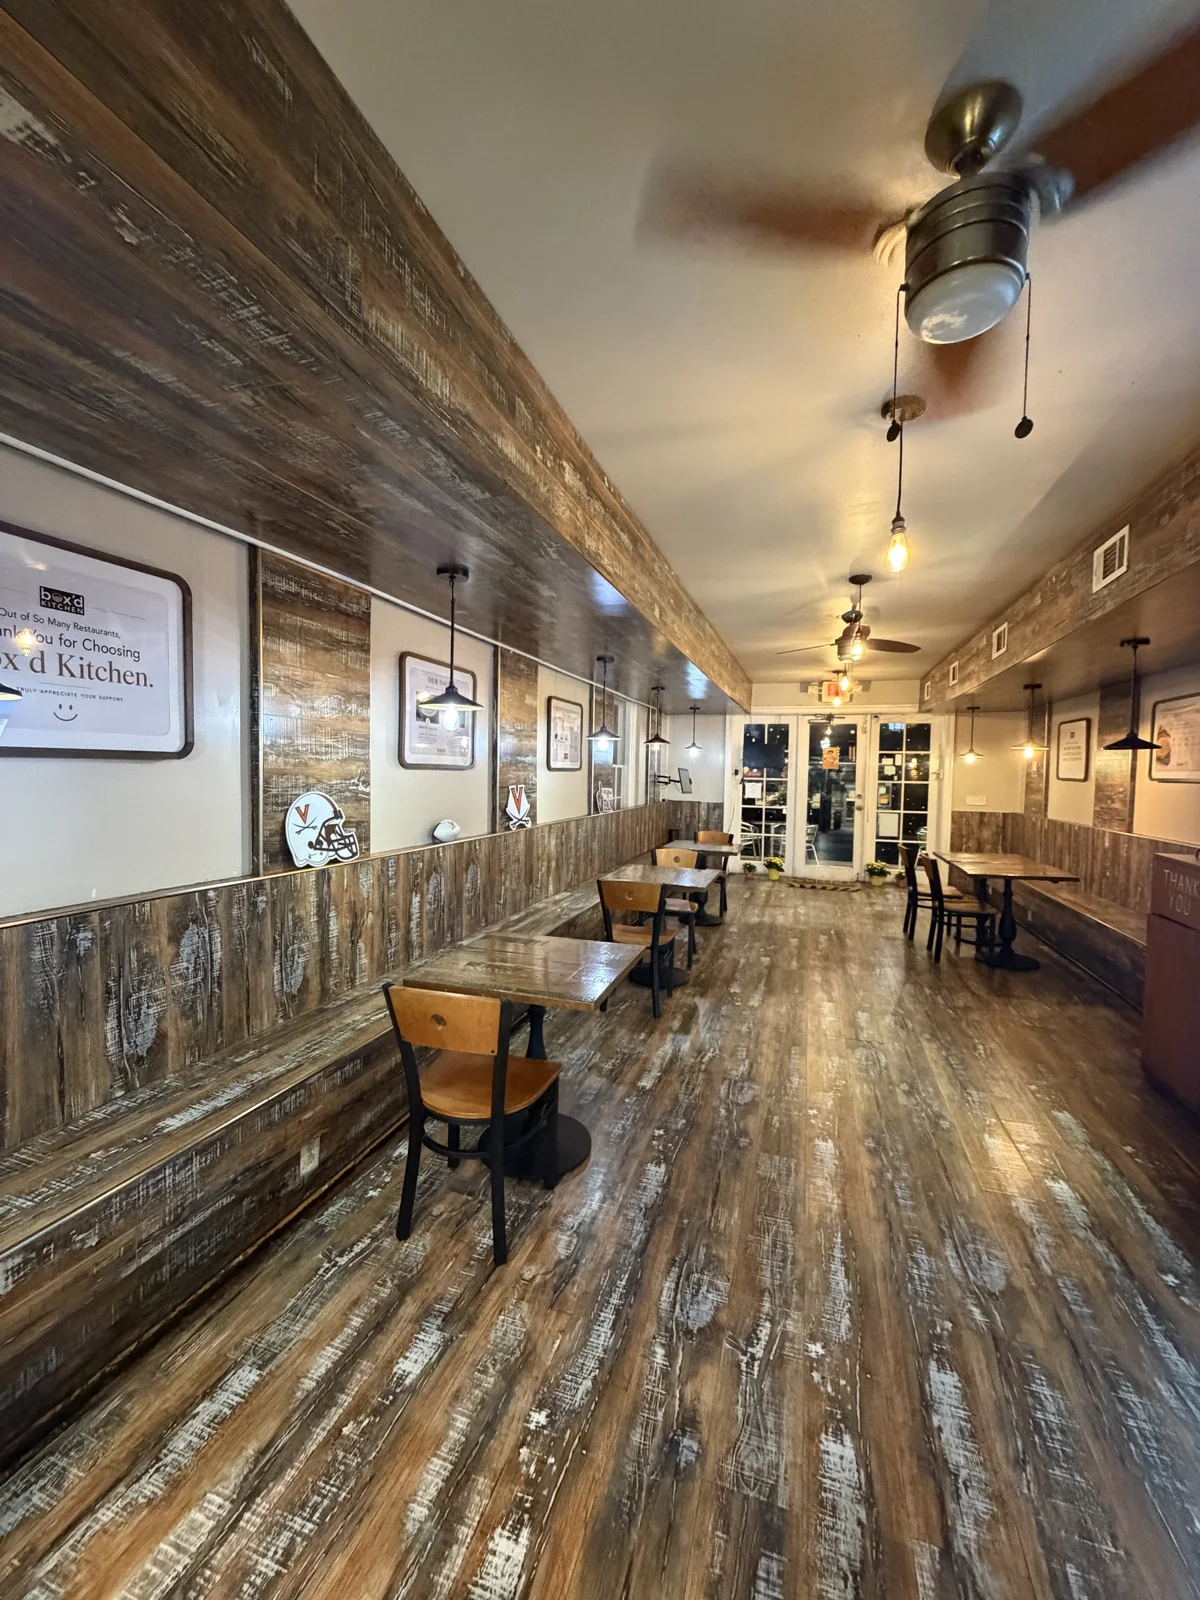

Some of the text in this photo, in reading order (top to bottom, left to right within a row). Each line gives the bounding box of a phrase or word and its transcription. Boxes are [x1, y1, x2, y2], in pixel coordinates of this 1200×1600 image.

[41, 600, 84, 615] KITCHEN
[0, 607, 121, 639] Out of So Many Restaurants,
[58, 633, 78, 649] for
[82, 638, 141, 662] Choosing
[56, 652, 154, 688] Kitchen.
[16, 686, 37, 694] TRULY
[40, 689, 78, 698] APPRECIATE
[1163, 869, 1200, 899] THANK
[1168, 890, 1191, 916] YOU
